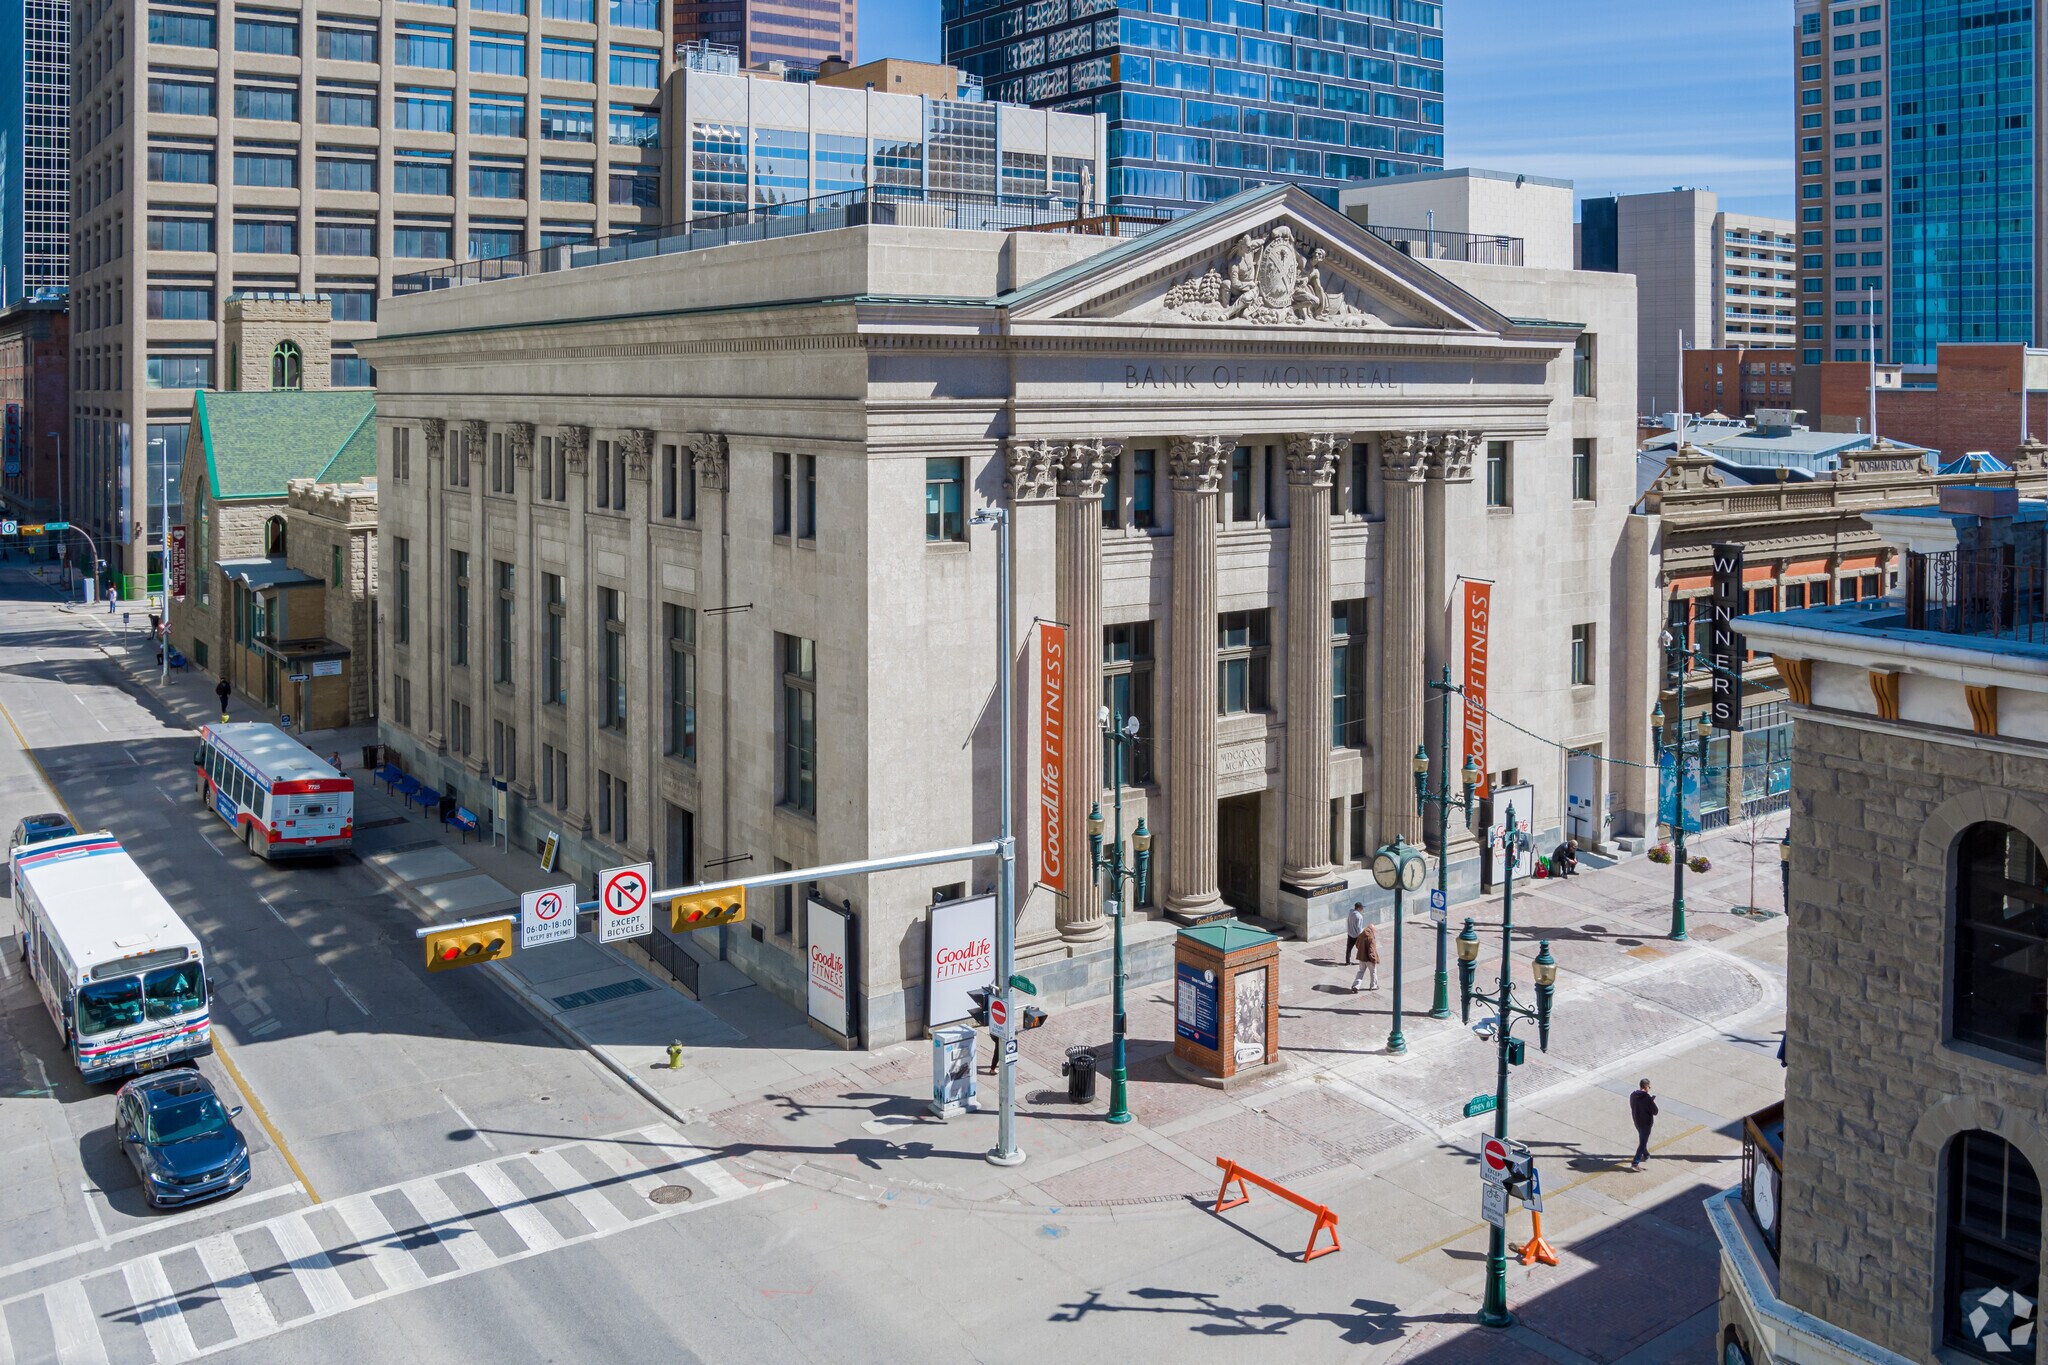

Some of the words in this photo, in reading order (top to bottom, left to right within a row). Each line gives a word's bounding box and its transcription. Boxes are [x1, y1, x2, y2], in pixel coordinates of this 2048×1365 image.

[1125, 365, 1198, 390] BANK
[1212, 366, 1247, 390] OF
[1262, 366, 1398, 390] MONTREAL
[1858, 460, 1890, 473] NORMAN
[1890, 459, 1914, 471] BLOCK
[1471, 594, 1488, 690] FITNESS
[1713, 557, 1736, 719] WINNERS
[1045, 642, 1062, 757] FITNESS
[1041, 762, 1061, 877] GoodLife
[1312, 888, 1329, 897] GoodLife
[526, 918, 572, 934] 06:00-18:00
[611, 915, 641, 927] EXCEPT
[1196, 914, 1214, 925] GoodLife
[527, 933, 545, 943] EXCEPT
[546, 931, 553, 939] BY
[553, 929, 571, 938] PERMIT
[607, 923, 645, 937] BICYCLES
[811, 944, 843, 972] GoodLife
[936, 937, 991, 965] GoodLife
[811, 961, 843, 988] FITNESS
[936, 955, 991, 978] FITNESS
[1484, 1173, 1503, 1184] BICYCLE
[1487, 1167, 1503, 1179] EXCEPT
[908, 1178, 946, 1192] PAVER
